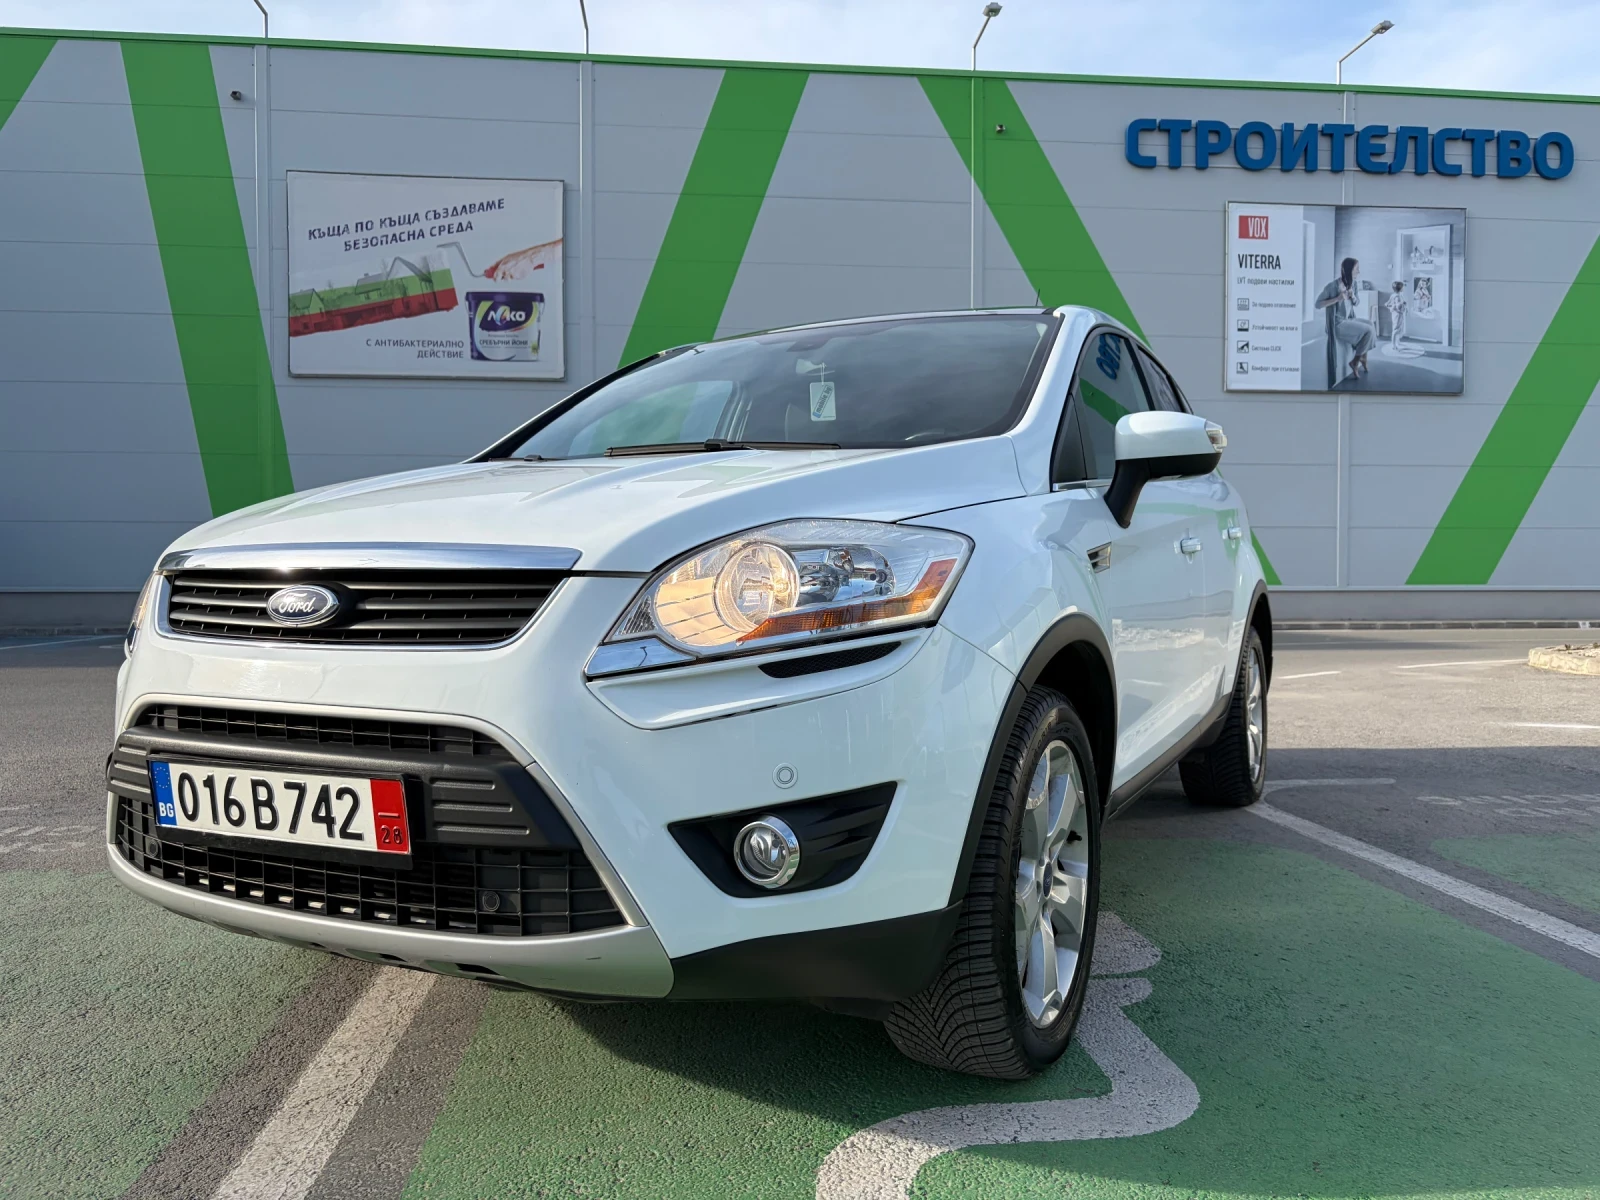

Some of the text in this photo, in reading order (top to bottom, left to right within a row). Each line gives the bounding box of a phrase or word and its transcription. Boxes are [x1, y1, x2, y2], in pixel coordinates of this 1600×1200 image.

[1125, 118, 1574, 180] СТРОИТЕЛСТВО
[308, 198, 505, 240] КЪЩА ПО КЪЩА СЪЗДАВАМЕ
[1248, 217, 1267, 238] VOX
[344, 220, 474, 252] БЕЗОПАСНА СРЕДА
[1237, 253, 1282, 270] VITERRA
[374, 338, 465, 349] АНТИБАКТЕРИАЛНО
[416, 348, 465, 359] ДЕЙСТВИЕ
[278, 592, 317, 614] Ford
[159, 801, 175, 818] BG
[381, 825, 403, 844] 28
